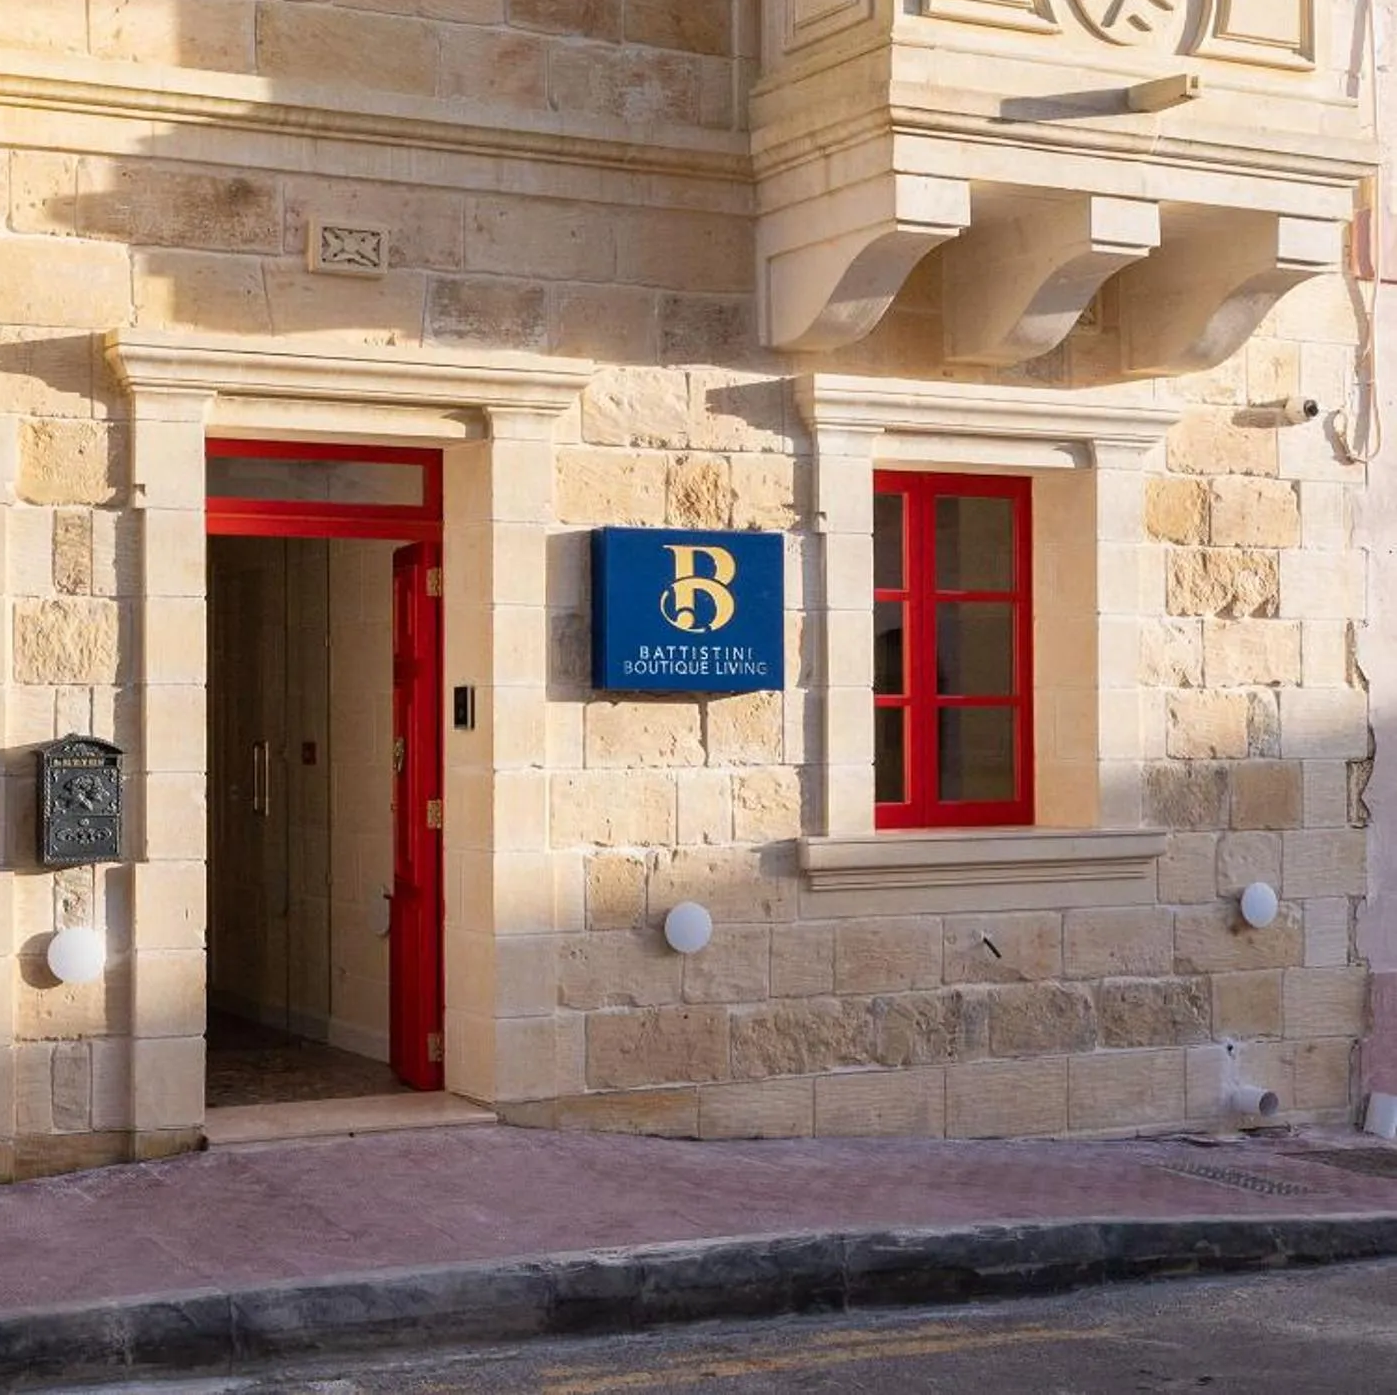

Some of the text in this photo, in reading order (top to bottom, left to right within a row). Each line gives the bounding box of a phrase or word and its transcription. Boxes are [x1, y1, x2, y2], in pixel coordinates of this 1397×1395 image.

[639, 645, 752, 660] BATTISTINI
[624, 660, 768, 675] BOUTIQUE LIVING
